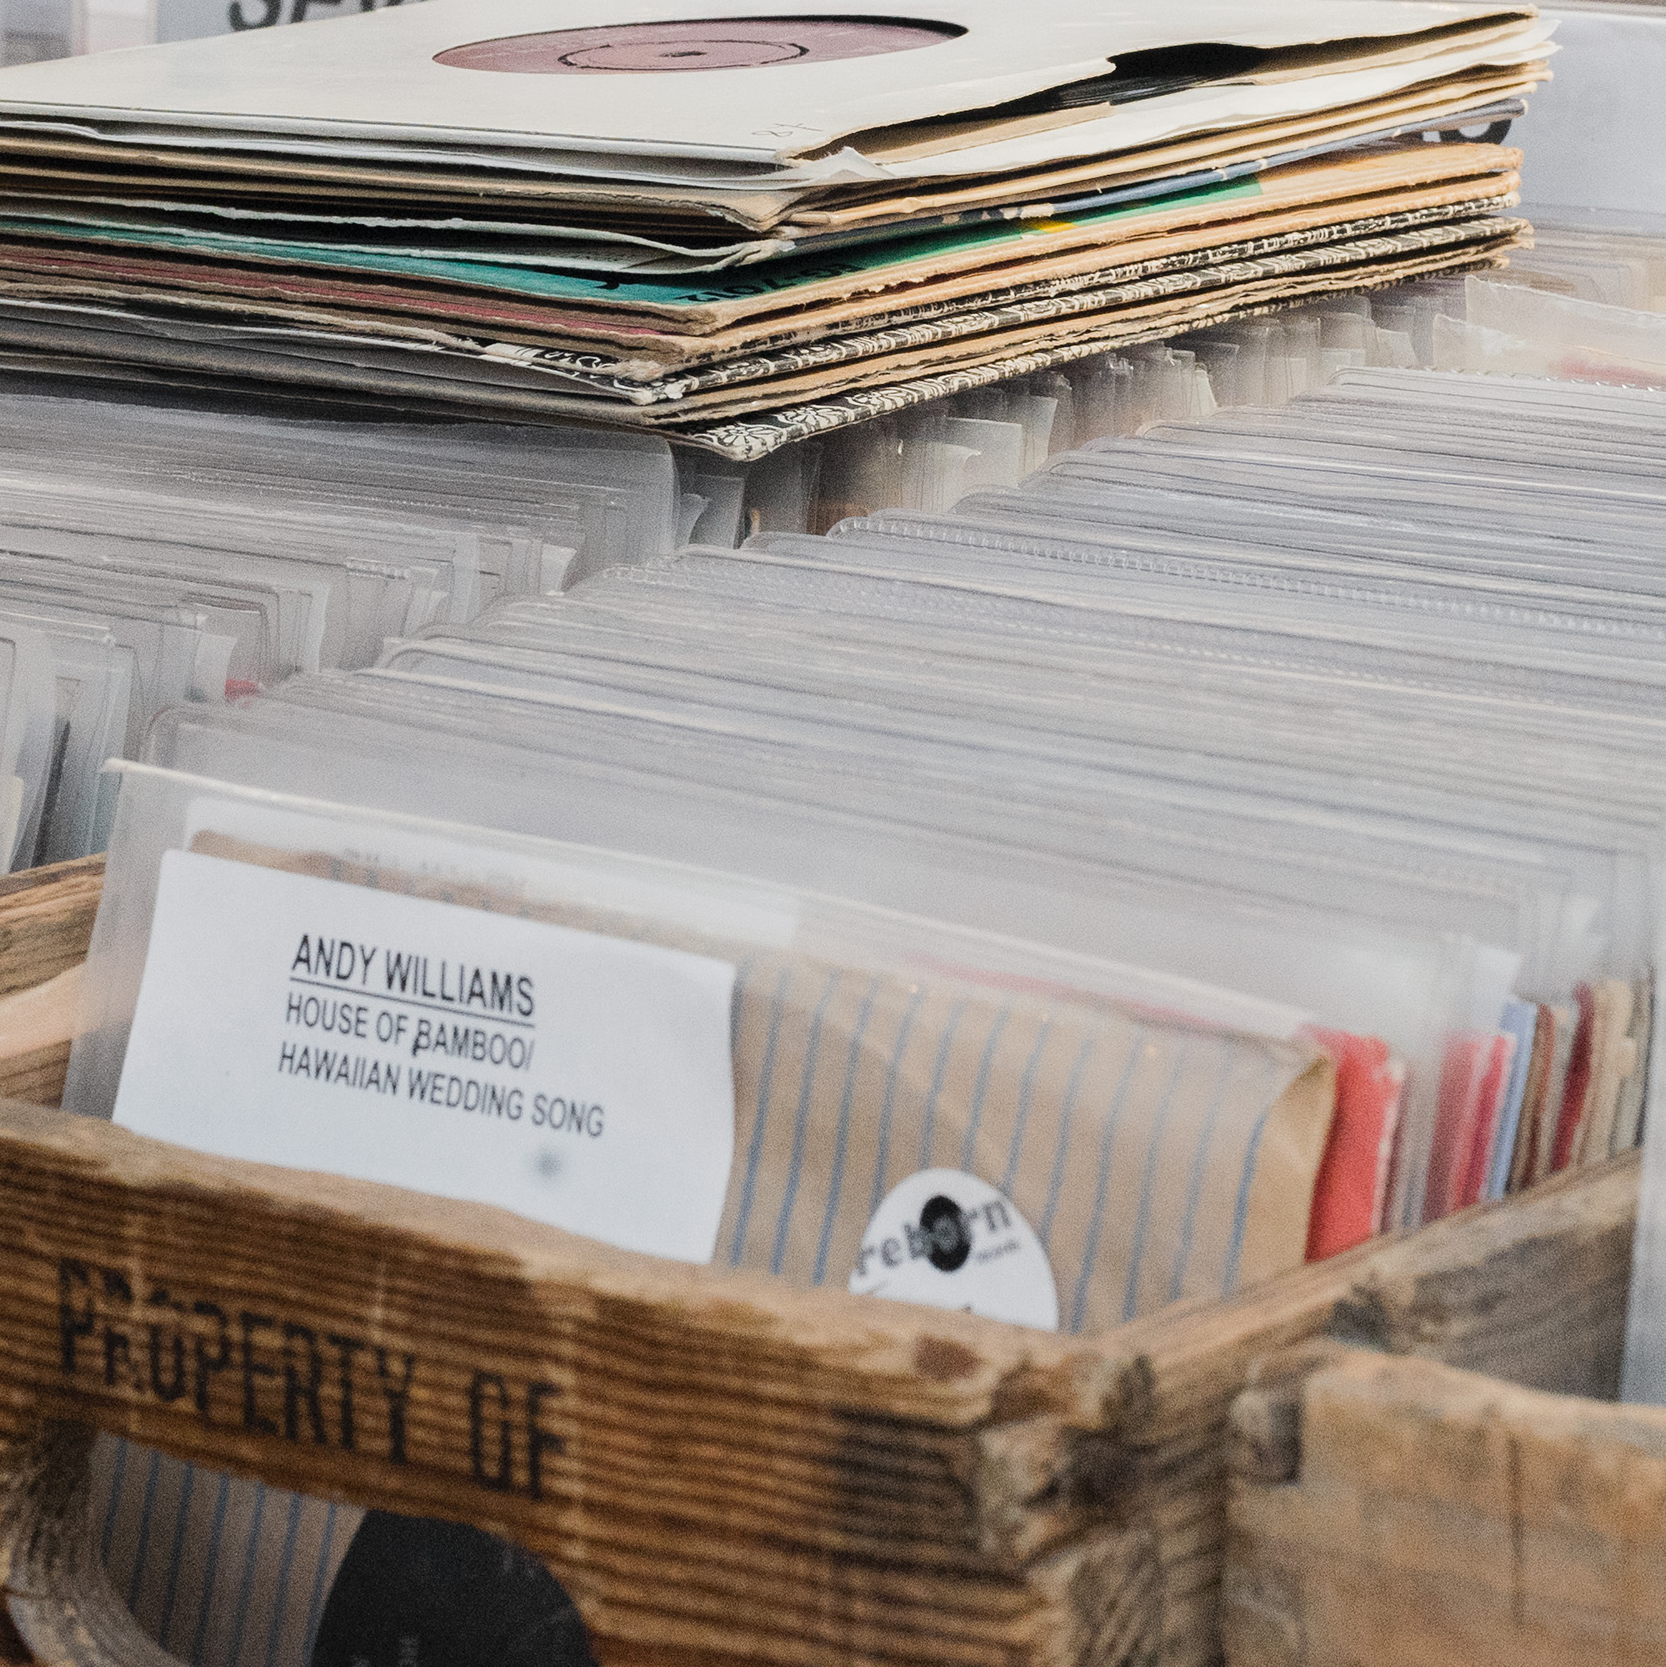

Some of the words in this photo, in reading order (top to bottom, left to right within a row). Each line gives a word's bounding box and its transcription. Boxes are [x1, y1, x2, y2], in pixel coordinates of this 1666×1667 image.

[285, 990, 369, 1039] HOUSE
[375, 1010, 410, 1046] OF
[291, 934, 378, 985] ANDY
[386, 948, 536, 1019] WILLIAMS
[278, 1040, 402, 1098] HAWAIIAN
[408, 1066, 525, 1122] WEDDING
[532, 1092, 606, 1140] SONG
[58, 1256, 417, 1465] PROPERTY
[470, 1367, 567, 1501] OF
